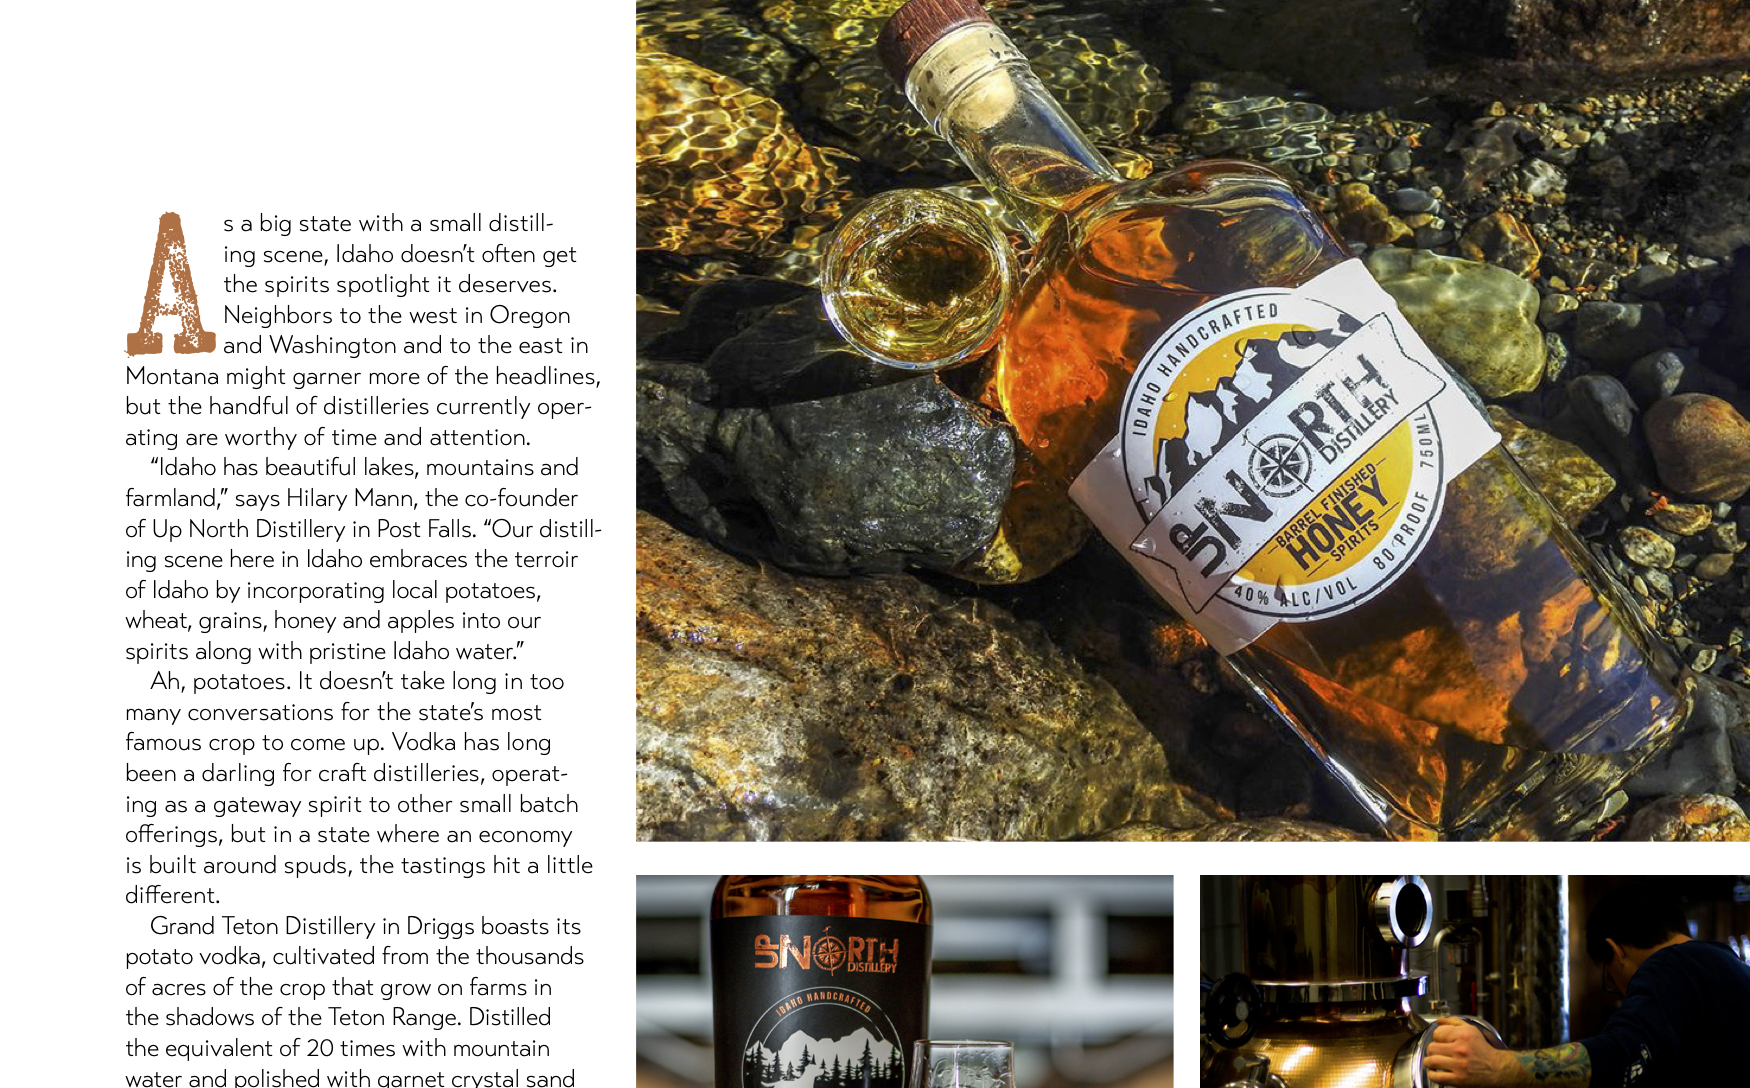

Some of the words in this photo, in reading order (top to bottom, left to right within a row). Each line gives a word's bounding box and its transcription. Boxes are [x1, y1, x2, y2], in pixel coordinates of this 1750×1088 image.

[240, 219, 253, 232] a
[260, 212, 292, 237] big
[299, 215, 352, 233] state
[358, 212, 404, 232] with
[410, 219, 422, 233] a
[429, 212, 482, 233] small
[488, 212, 554, 233] distill-
[224, 245, 256, 268] ing
[263, 250, 329, 267] scene,
[336, 243, 394, 264] Idaho
[481, 243, 536, 264] often
[542, 246, 577, 268] get
[223, 273, 258, 294] the
[264, 275, 330, 298] spirits
[336, 273, 430, 298] spotlight
[437, 275, 452, 293] it
[458, 273, 557, 294] deserves.
[224, 304, 333, 329] Neighbors
[339, 307, 362, 324] to
[367, 304, 403, 324] the
[408, 307, 458, 325] west
[465, 306, 483, 324] in
[489, 304, 571, 329] Oregon
[223, 334, 262, 355] and
[268, 334, 397, 359] Washington
[403, 334, 442, 355] and
[449, 337, 471, 354] to
[477, 334, 513, 354] the
[518, 337, 563, 355] east
[570, 336, 589, 354] in
[1132, 382, 1161, 436] IDAHO
[1157, 303, 1278, 377] HANDCRAFTED
[1319, 388, 1399, 464] DISTILLERY
[1194, 353, 1390, 550] NORTH
[223, 456, 259, 477] has
[265, 456, 356, 477] beautiful
[364, 456, 419, 480] lakes,
[426, 458, 535, 477] mountains
[540, 456, 579, 477] and
[1234, 585, 1269, 605] 40%
[1279, 576, 1358, 607] ALC/VOL
[1372, 548, 1395, 571] 80
[1394, 491, 1430, 546] PROOF
[1414, 413, 1434, 468] 750ML
[1276, 508, 1323, 548] BARREL
[1320, 462, 1377, 511] FINISHED
[1286, 475, 1388, 571] HONEY
[1169, 522, 1227, 579] UP
[1331, 519, 1380, 562] SPIRITS
[150, 915, 215, 936] Grand
[221, 915, 279, 936] Teton
[285, 915, 376, 940] Distillery
[382, 917, 400, 935] in
[407, 915, 475, 940] Driggs
[481, 915, 550, 936] boasts
[556, 917, 582, 936] its
[754, 934, 779, 969] UP
[778, 934, 899, 970] NORTH
[847, 961, 898, 973] DISTILLERY
[775, 997, 803, 1017] IDAHO
[806, 991, 872, 1014] HANDCRAFTED
